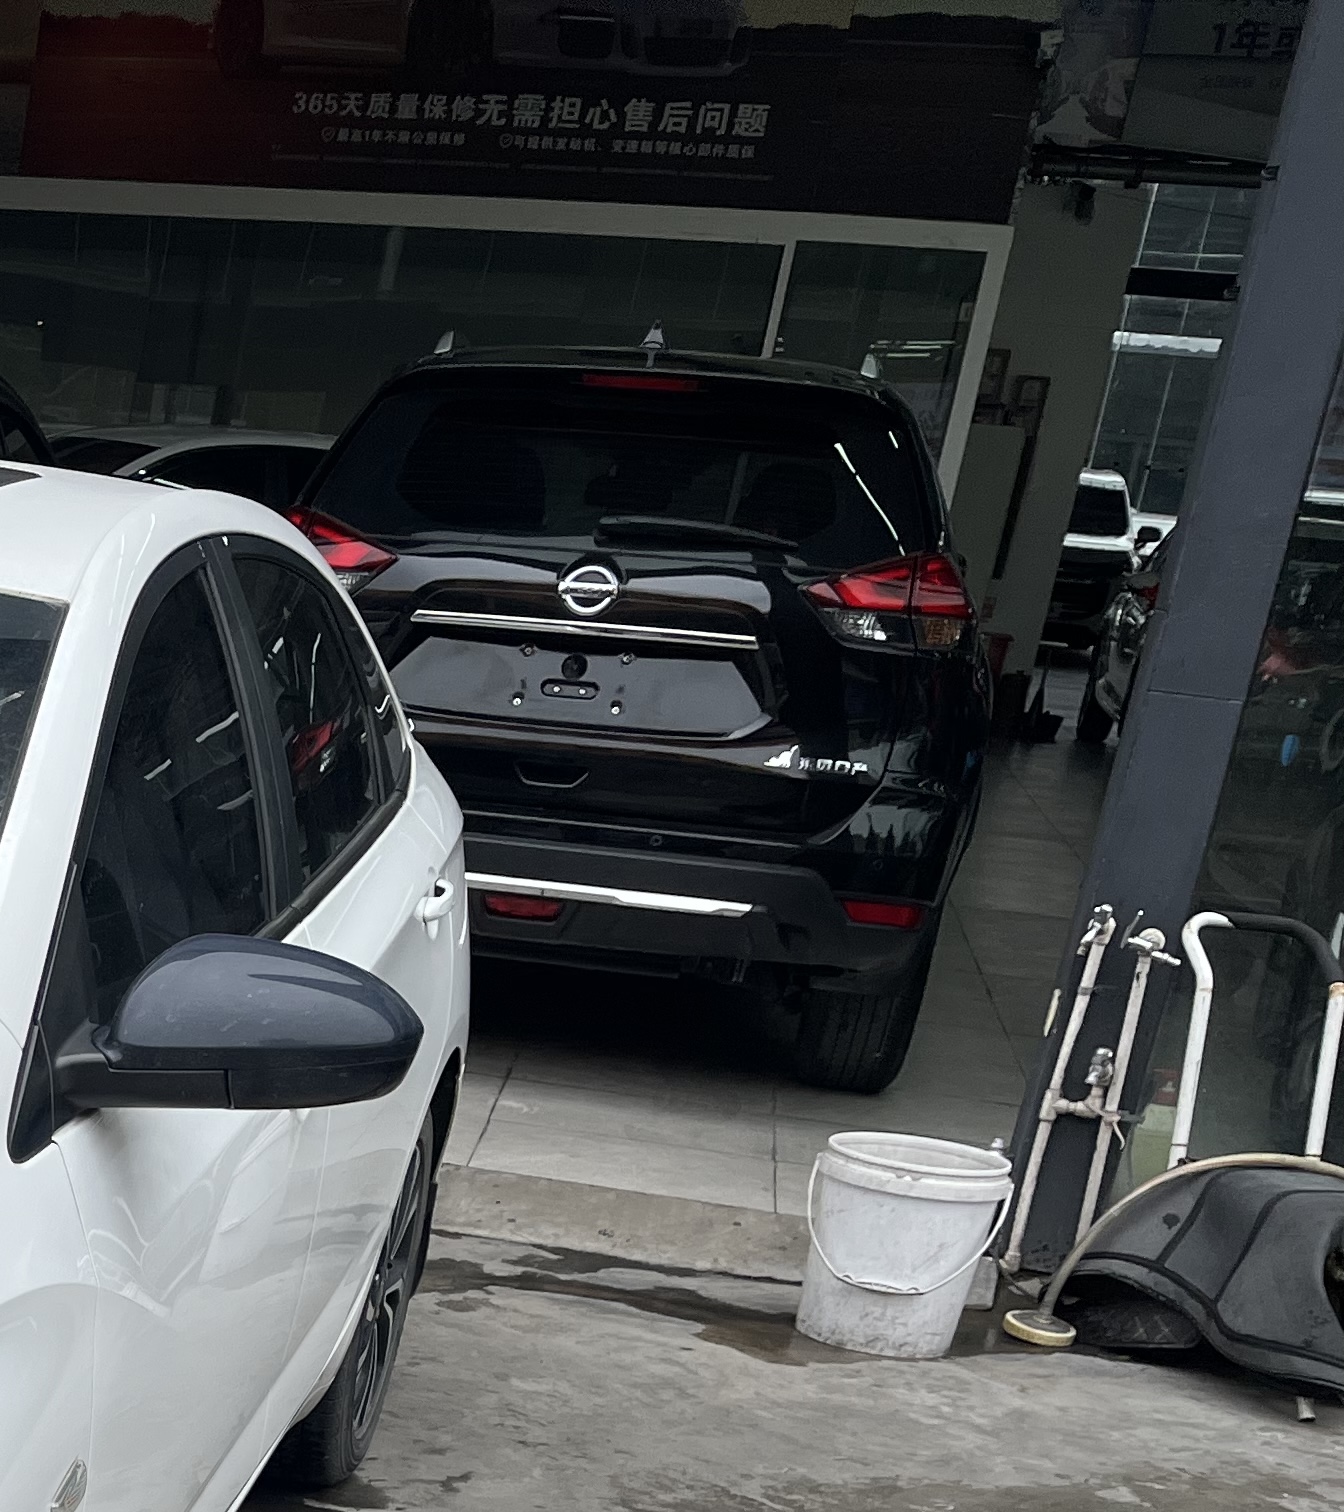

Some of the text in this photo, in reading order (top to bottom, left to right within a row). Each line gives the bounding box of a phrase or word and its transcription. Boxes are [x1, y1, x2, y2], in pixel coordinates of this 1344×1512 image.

[293, 91, 770, 137] 365天质量保修无需担心售后问题
